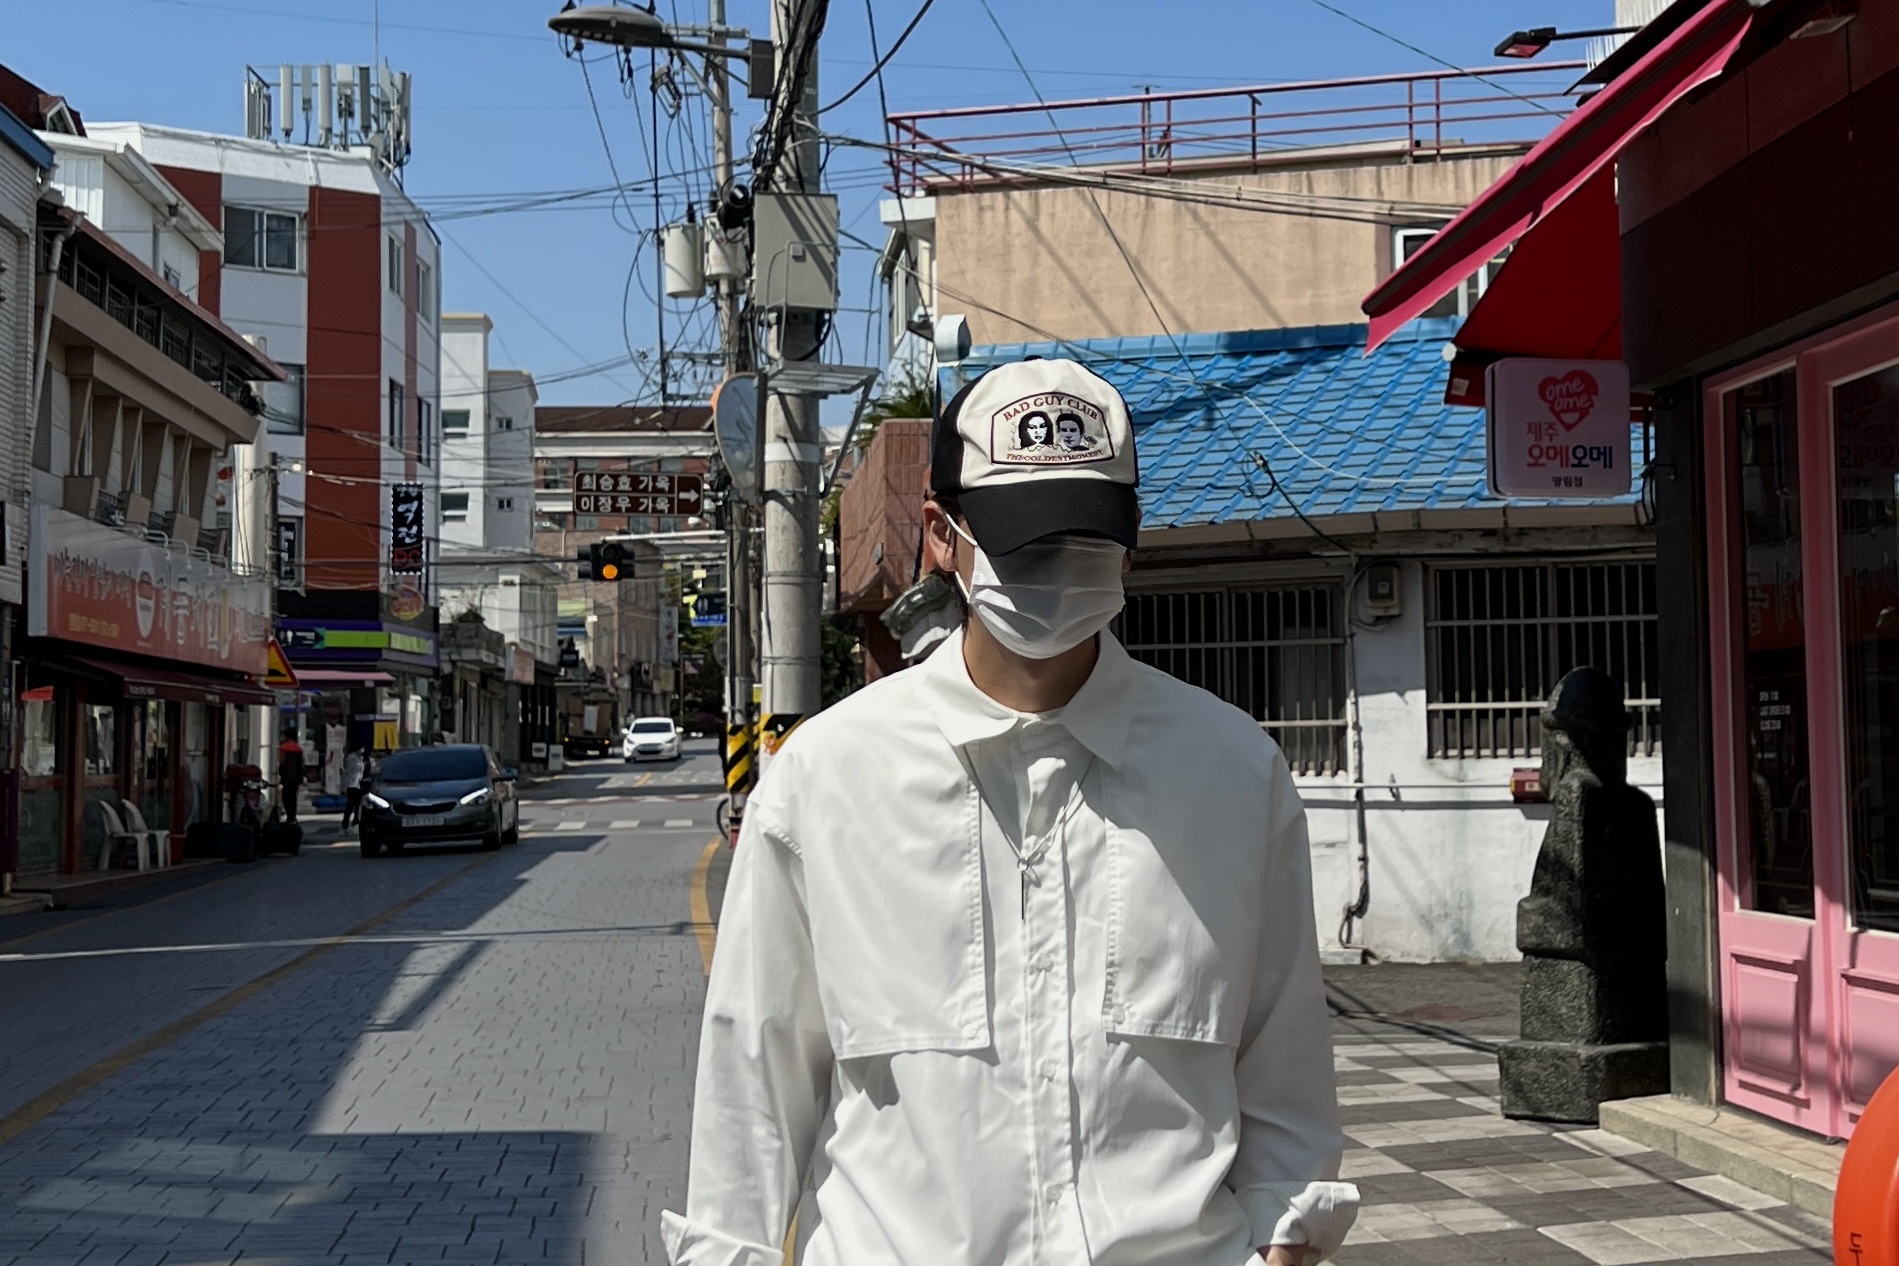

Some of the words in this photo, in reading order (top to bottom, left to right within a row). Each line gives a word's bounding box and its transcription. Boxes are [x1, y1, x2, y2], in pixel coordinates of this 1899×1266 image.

[1545, 377, 1586, 400] ome
[1003, 401, 1031, 421] BAD
[1033, 395, 1065, 408] GUY
[1067, 399, 1099, 421] CLUB
[1554, 395, 1592, 411] ome
[1526, 421, 1559, 443] 제주
[1526, 444, 1613, 469] 오메오메
[581, 473, 632, 491] 최승효
[638, 475, 671, 493] 가옥
[580, 495, 632, 513] 이장우
[638, 496, 671, 514] 가옥
